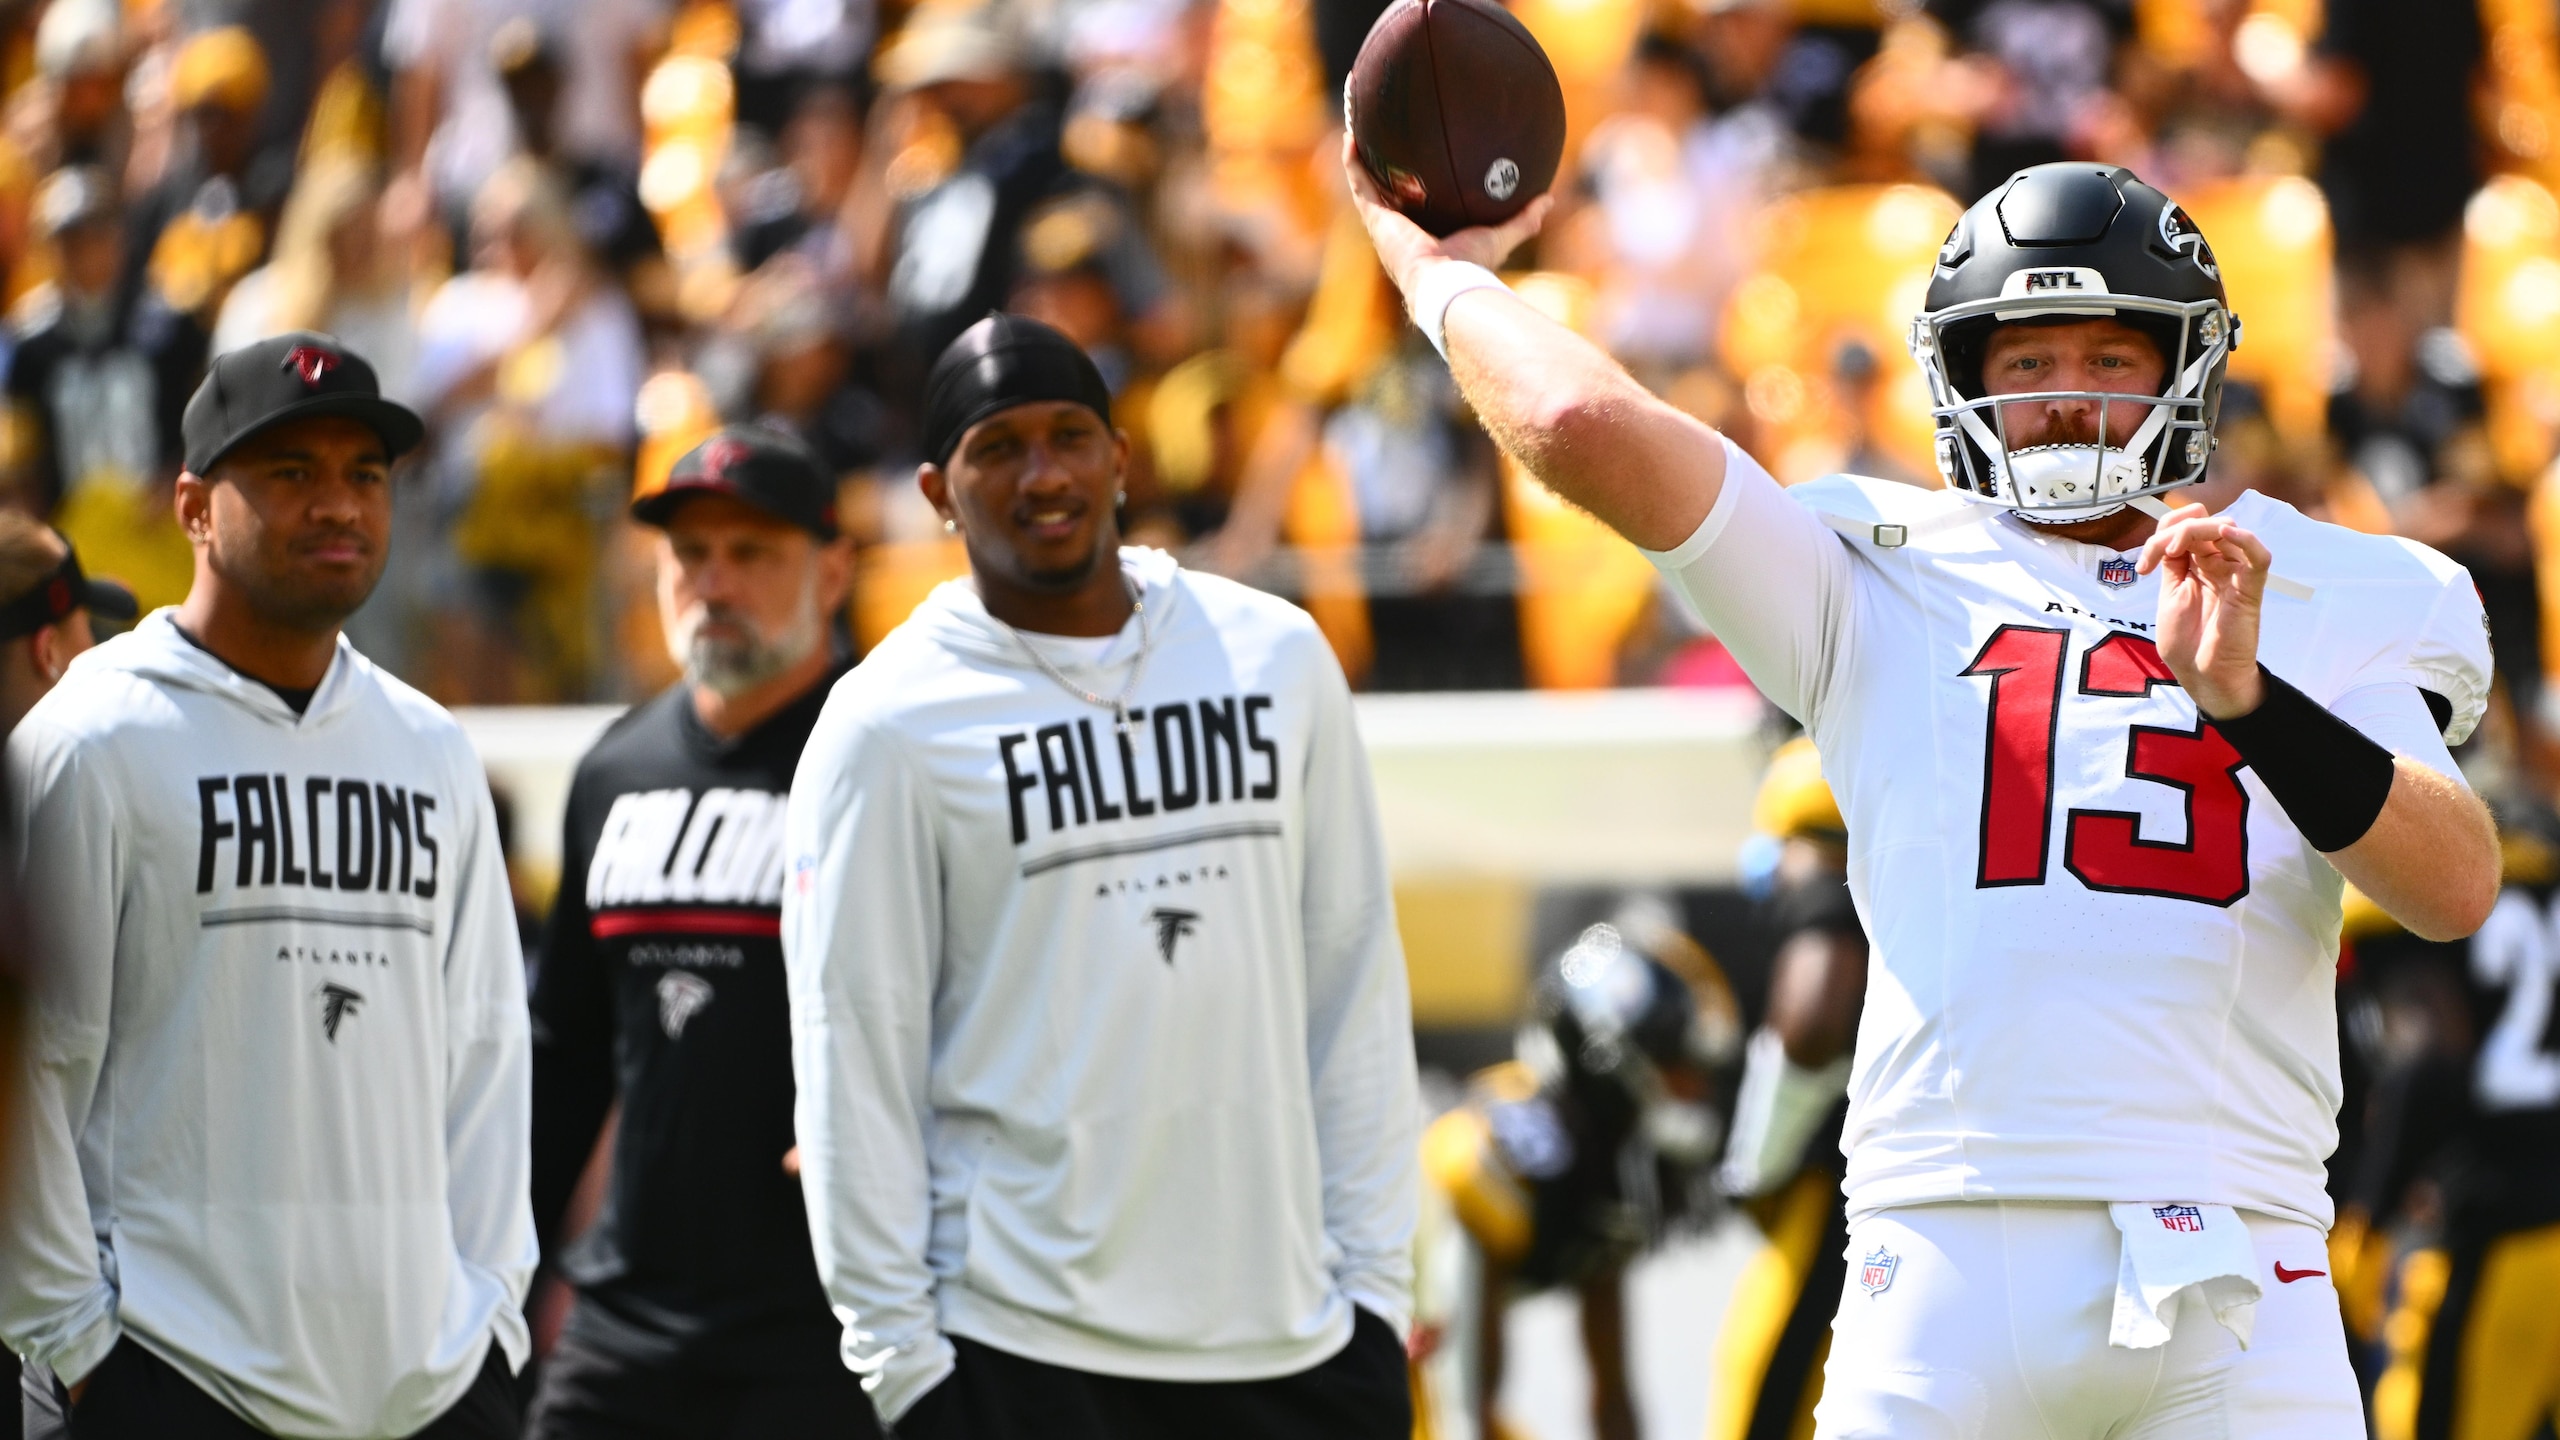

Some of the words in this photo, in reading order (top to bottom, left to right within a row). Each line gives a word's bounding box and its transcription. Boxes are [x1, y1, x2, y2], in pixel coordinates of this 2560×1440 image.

[2024, 271, 2083, 295] ATL
[2044, 601, 2156, 632] ATLAN
[999, 694, 1279, 846] FALCONS
[1957, 623, 2250, 908] 13
[197, 773, 437, 899] FALCONS
[585, 786, 790, 909] FALCON
[1095, 864, 1229, 899] ATLANTA
[276, 945, 391, 969] ATLANTA
[2472, 886, 2560, 1106] 2
[2160, 1216, 2200, 1232] NFL
[1863, 1267, 1886, 1287] NFL
